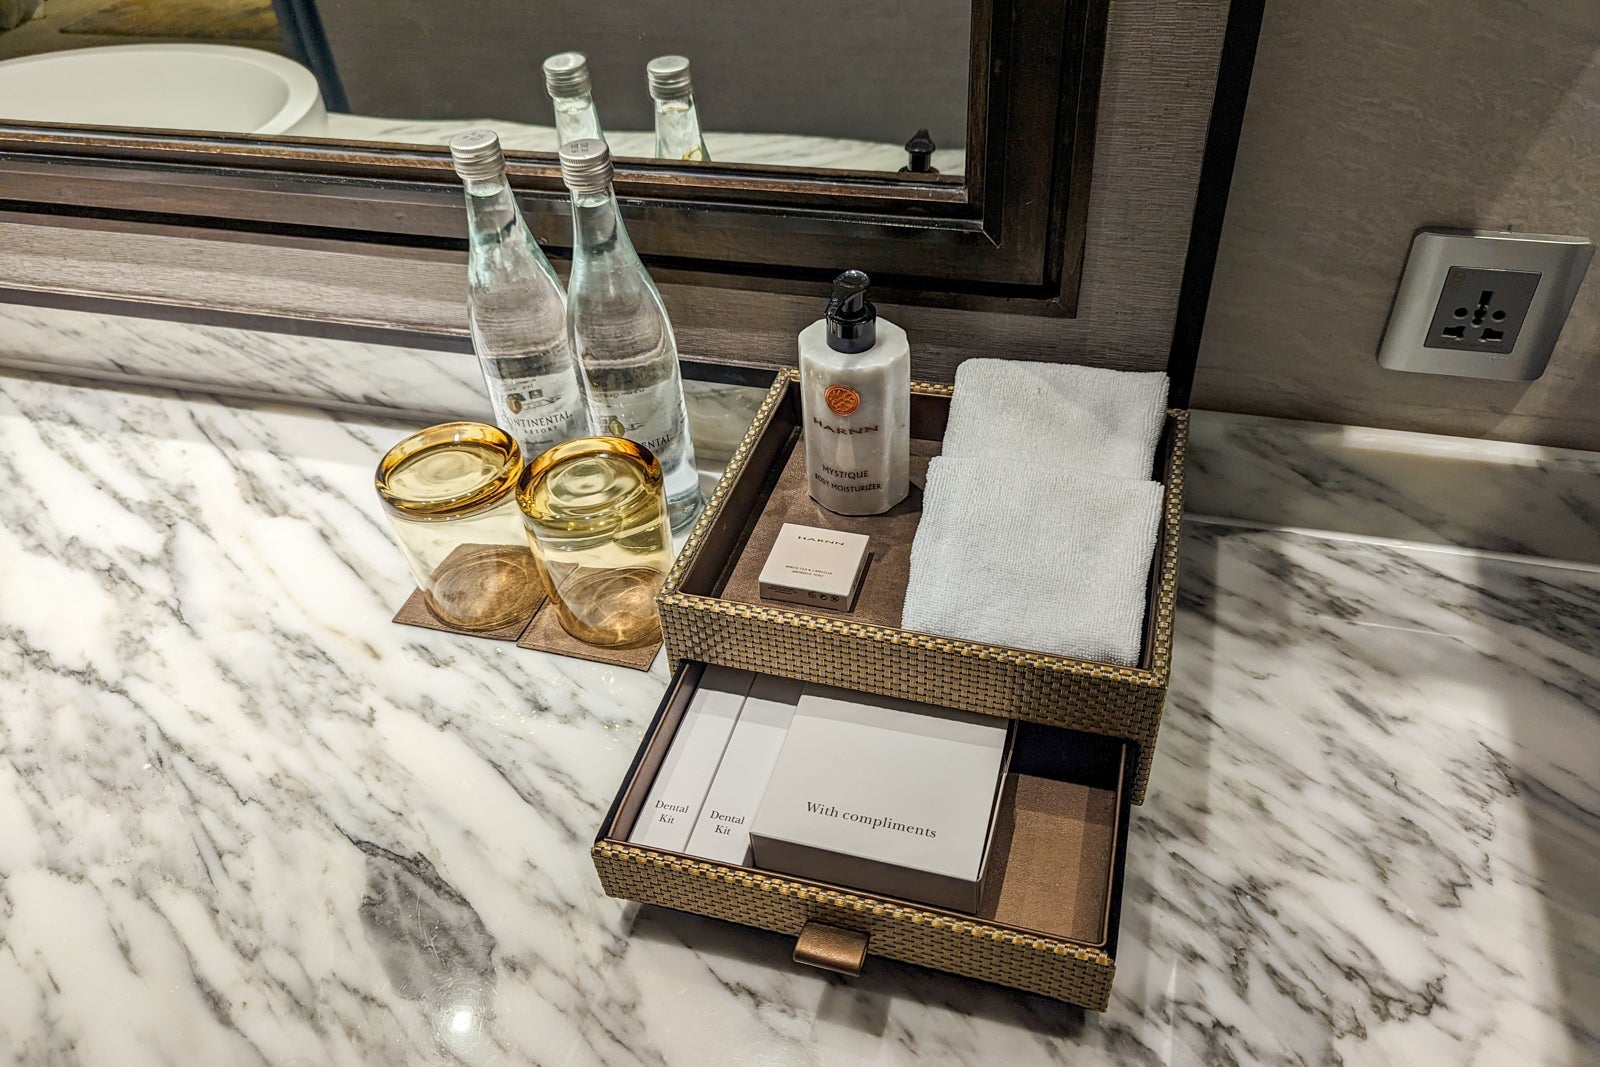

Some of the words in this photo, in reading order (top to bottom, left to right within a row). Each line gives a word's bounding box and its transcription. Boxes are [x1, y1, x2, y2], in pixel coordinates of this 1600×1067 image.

[813, 417, 879, 435] HARNN
[822, 464, 869, 480] MYSTIQUE
[814, 473, 829, 486] BODY
[831, 482, 882, 493] MOISTURIZER
[655, 800, 690, 814] Dental
[658, 814, 675, 825] Kit
[710, 810, 746, 825] Dental
[806, 801, 839, 818] With
[842, 811, 937, 838] compliments
[714, 824, 731, 836] Kit
